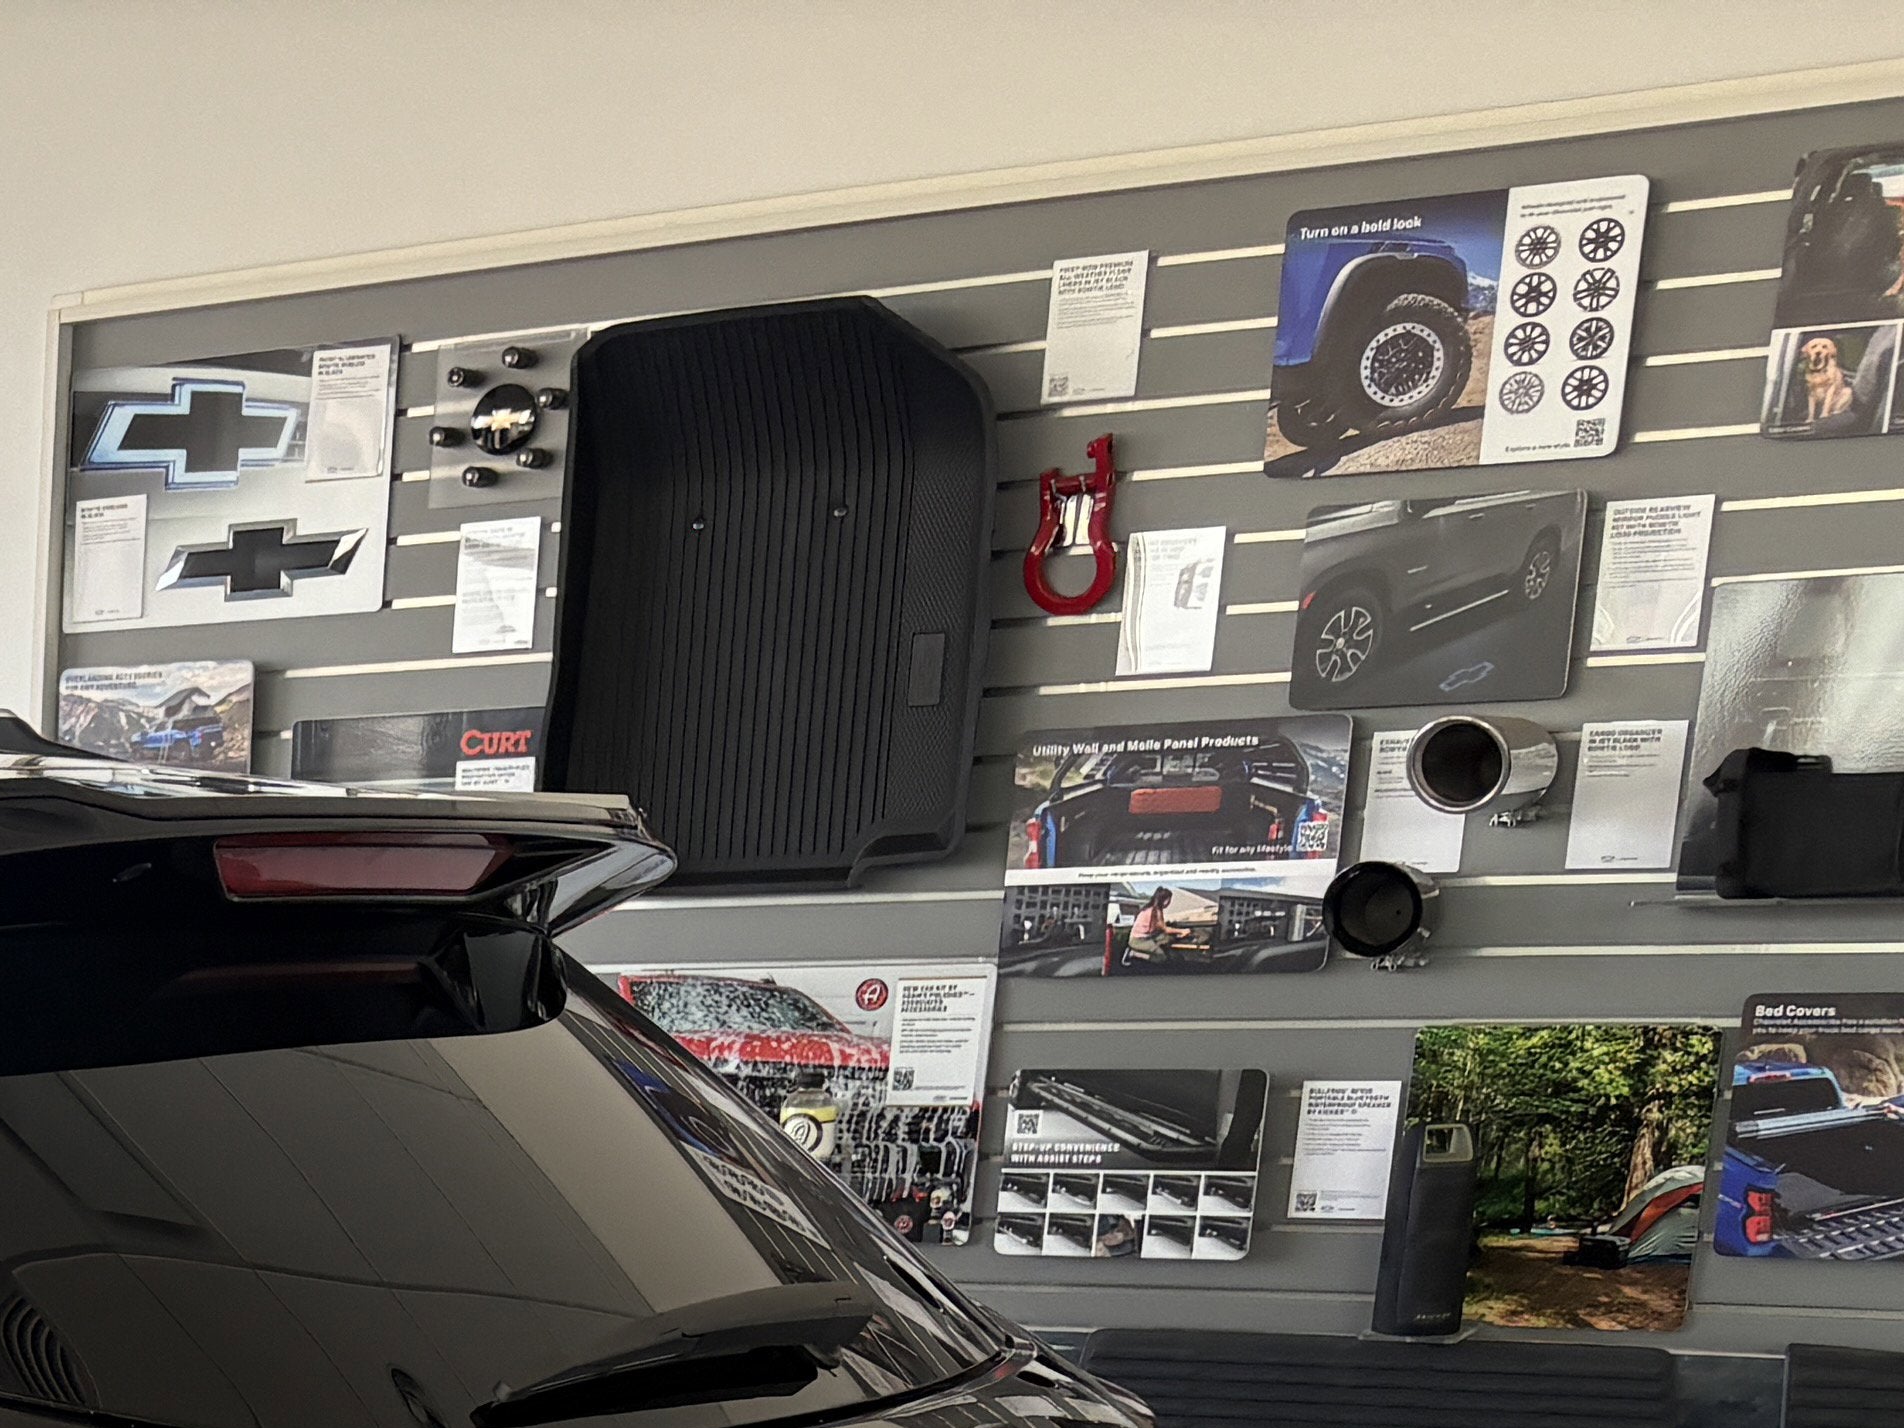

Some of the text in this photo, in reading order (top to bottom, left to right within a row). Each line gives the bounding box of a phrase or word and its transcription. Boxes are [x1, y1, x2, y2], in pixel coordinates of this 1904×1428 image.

[1300, 215, 1422, 240] Turn on a bold look
[460, 728, 533, 757] CURT
[1032, 735, 1260, 757] Utility Wall and Molle Panel Products
[1755, 1004, 1837, 1017] Bed Covers
[1054, 1142, 1121, 1152] CONVENIENCE
[1011, 1154, 1102, 1164] WITH ASSIST STEPS
